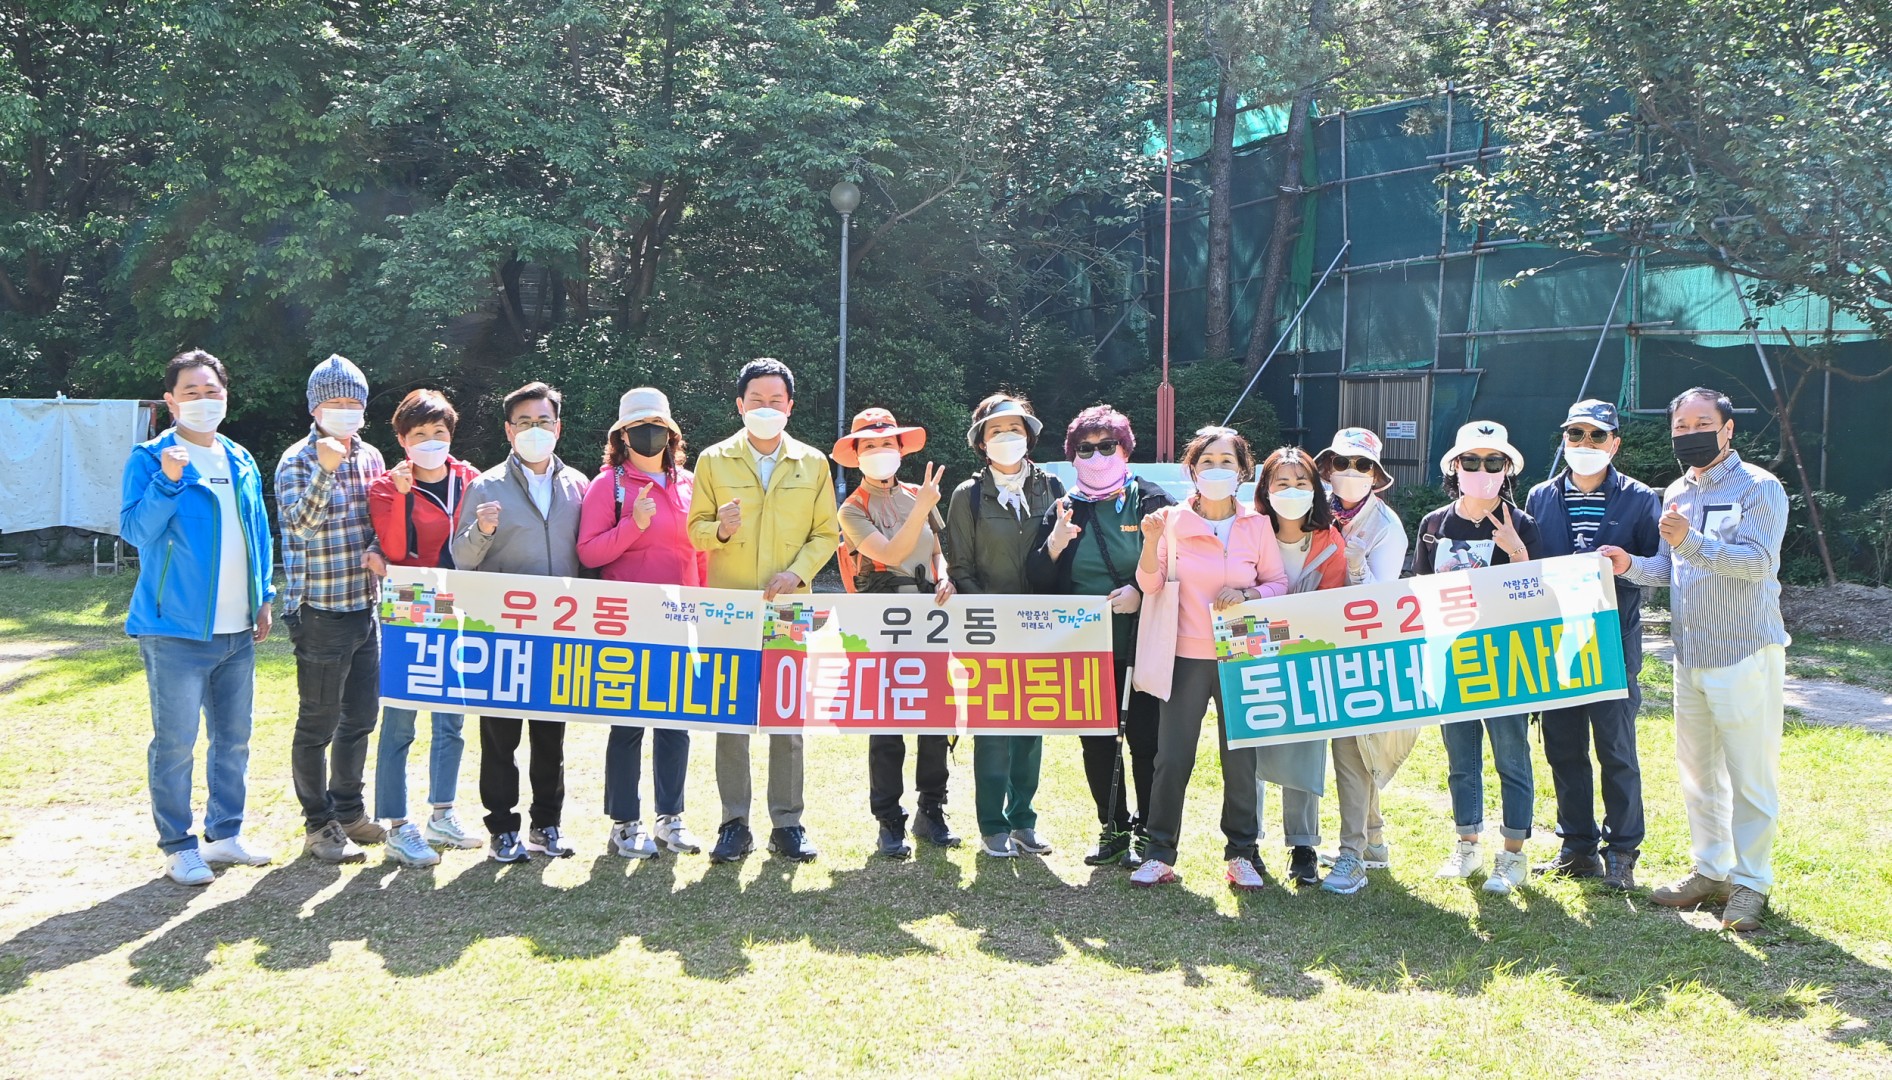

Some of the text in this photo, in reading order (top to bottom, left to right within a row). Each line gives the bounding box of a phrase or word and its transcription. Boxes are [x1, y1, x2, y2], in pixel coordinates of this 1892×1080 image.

[1503, 577, 1539, 591] 사람중심
[1508, 588, 1545, 601] 미래도시
[665, 613, 699, 623] 미래도시
[699, 602, 754, 625] 해운대
[1017, 610, 1049, 621] 사람중심
[1052, 607, 1102, 629] 해운대
[1021, 622, 1053, 631] 미래도시
[405, 632, 739, 716] 걸으며 배웁니다!
[1239, 620, 1604, 731] 동네방네 탐사대
[775, 655, 1103, 722] 아름다운 우리동네
